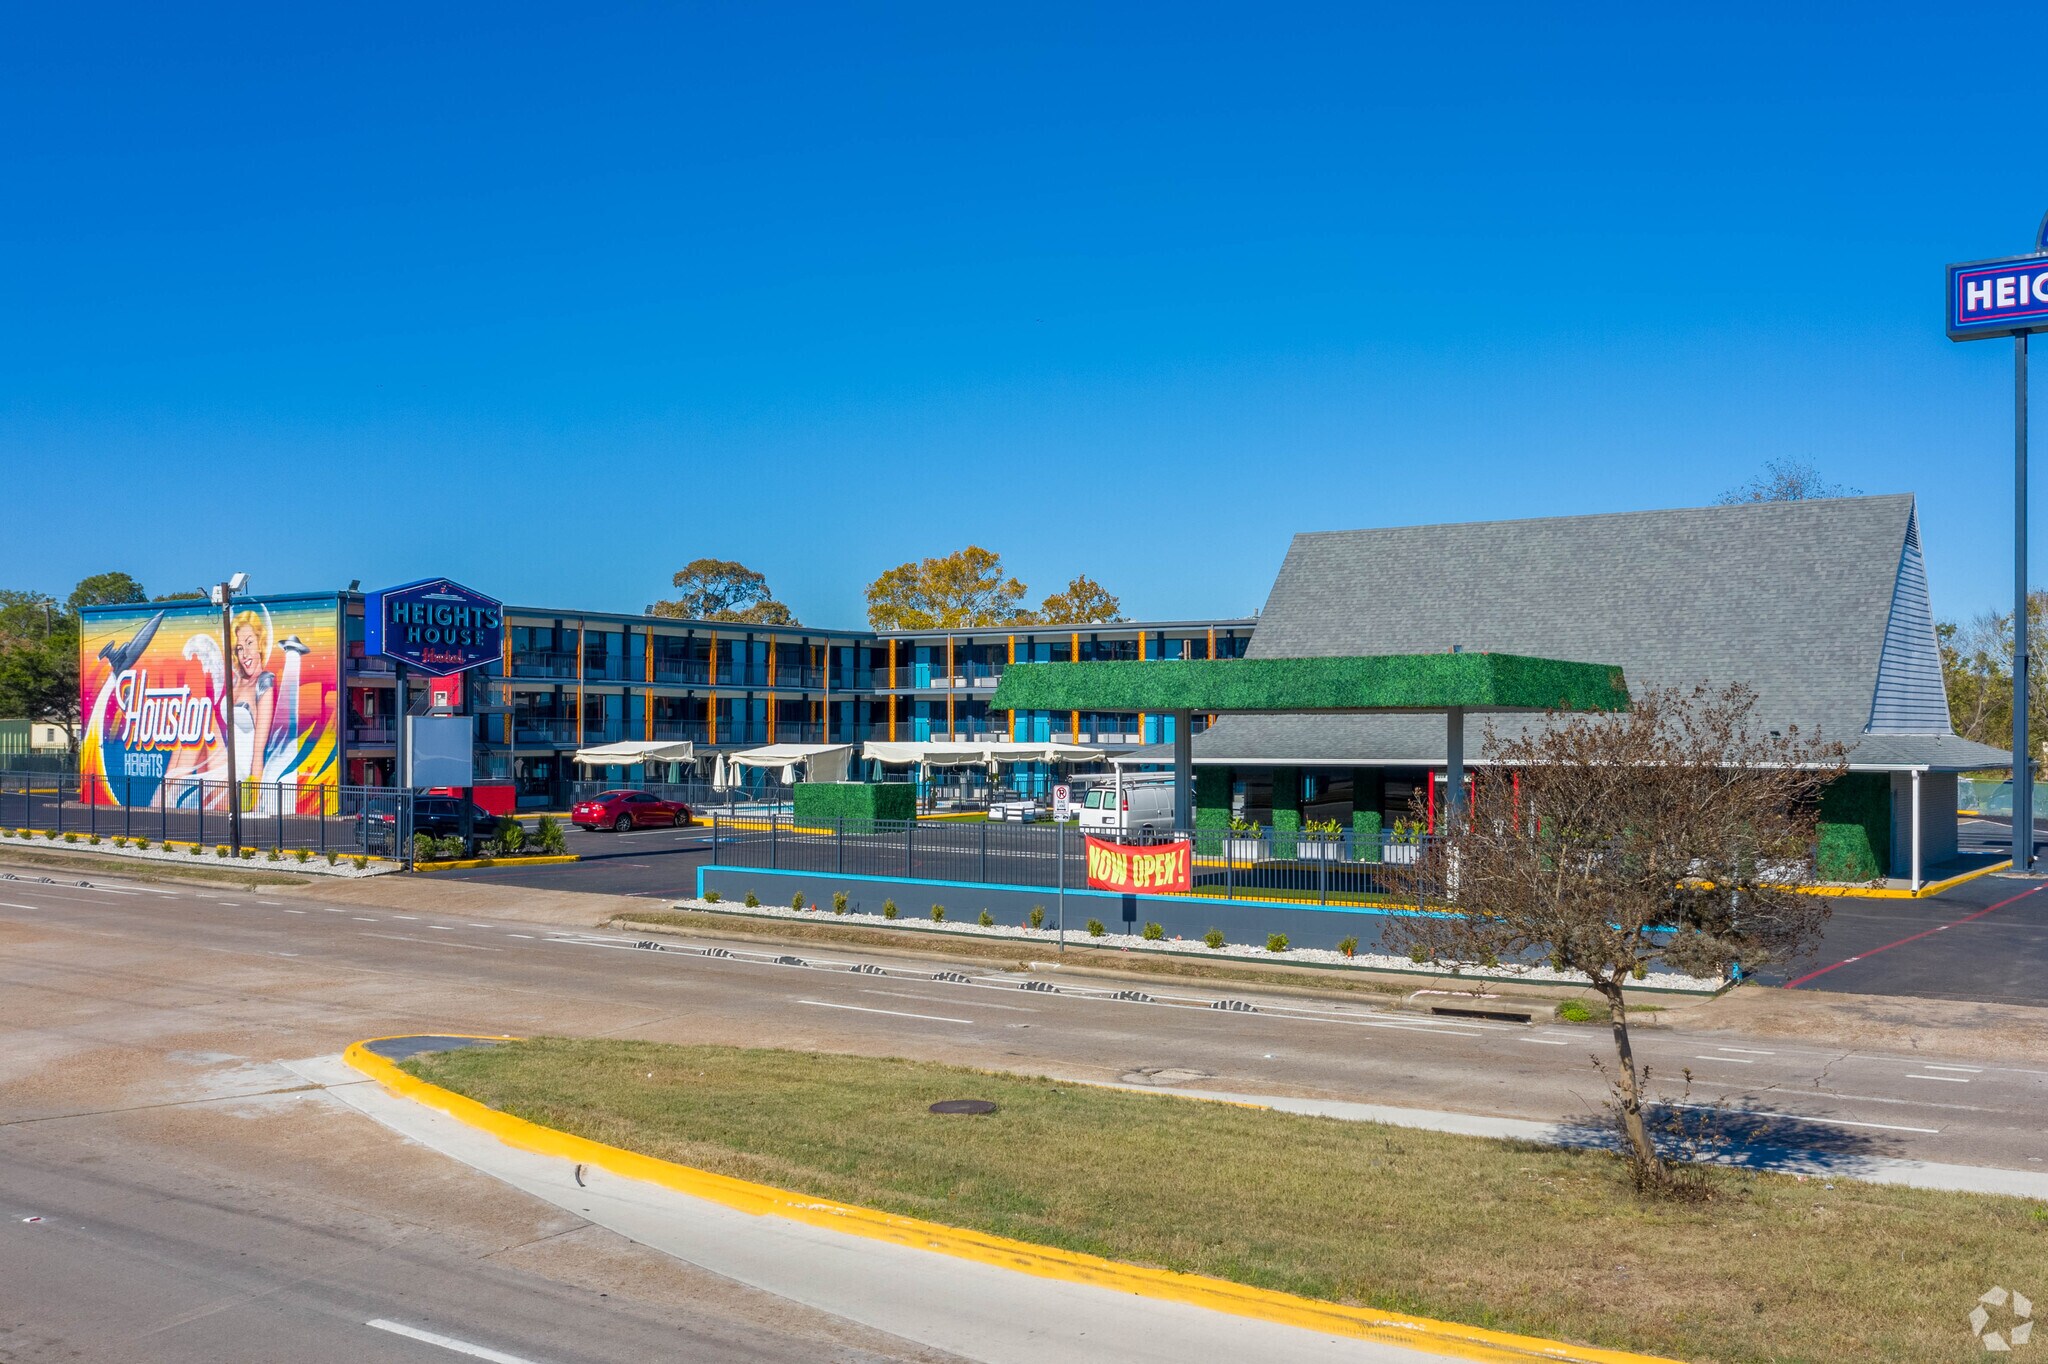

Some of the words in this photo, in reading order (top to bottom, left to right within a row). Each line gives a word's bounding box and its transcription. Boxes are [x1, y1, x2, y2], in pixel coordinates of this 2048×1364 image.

[392, 602, 499, 629] HEIGHTS
[407, 626, 484, 646] HOUSE
[116, 669, 217, 749] Houston
[124, 753, 164, 778] HEIGHTS
[1088, 845, 1128, 886] NOW
